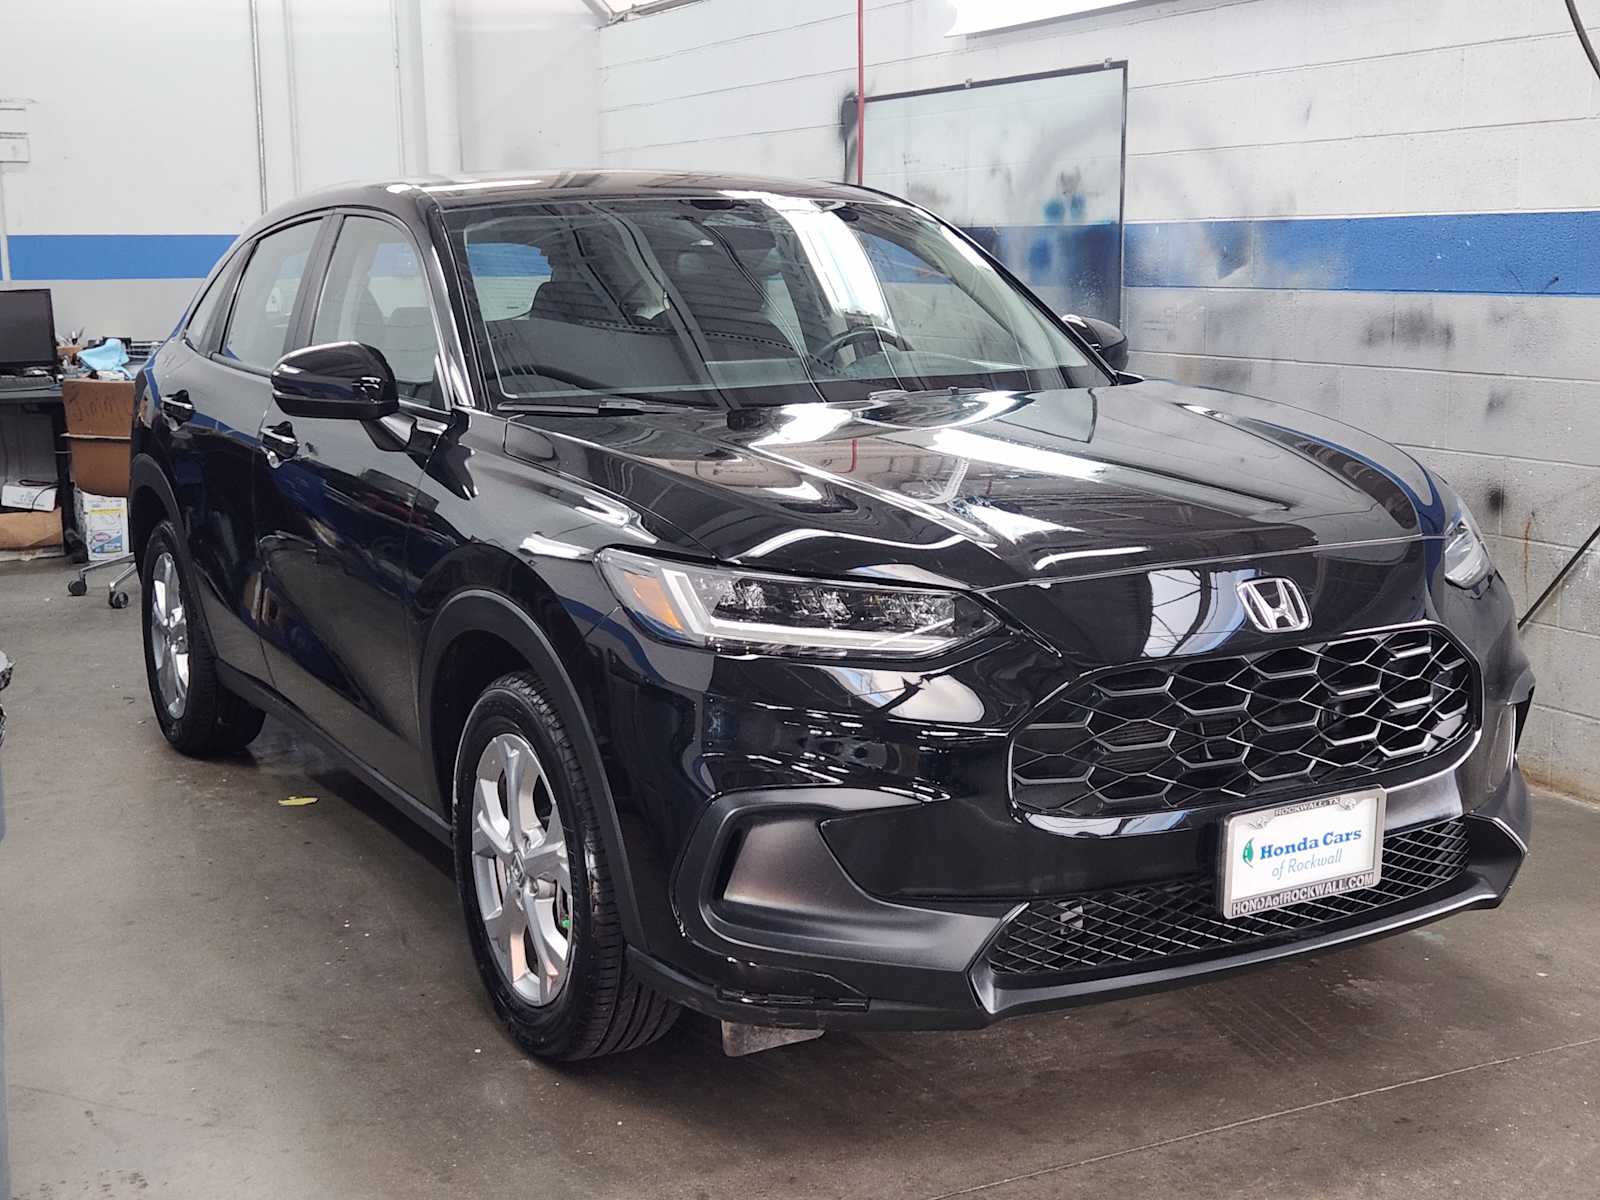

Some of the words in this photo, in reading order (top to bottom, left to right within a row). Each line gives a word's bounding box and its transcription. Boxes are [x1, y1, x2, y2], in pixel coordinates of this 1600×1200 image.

[1259, 836, 1319, 861] Honda
[1322, 829, 1362, 847] Cars
[1271, 861, 1286, 880] of
[1287, 848, 1343, 874] Rockwall
[1232, 872, 1374, 916] HONDAofROCKWALL.COM
